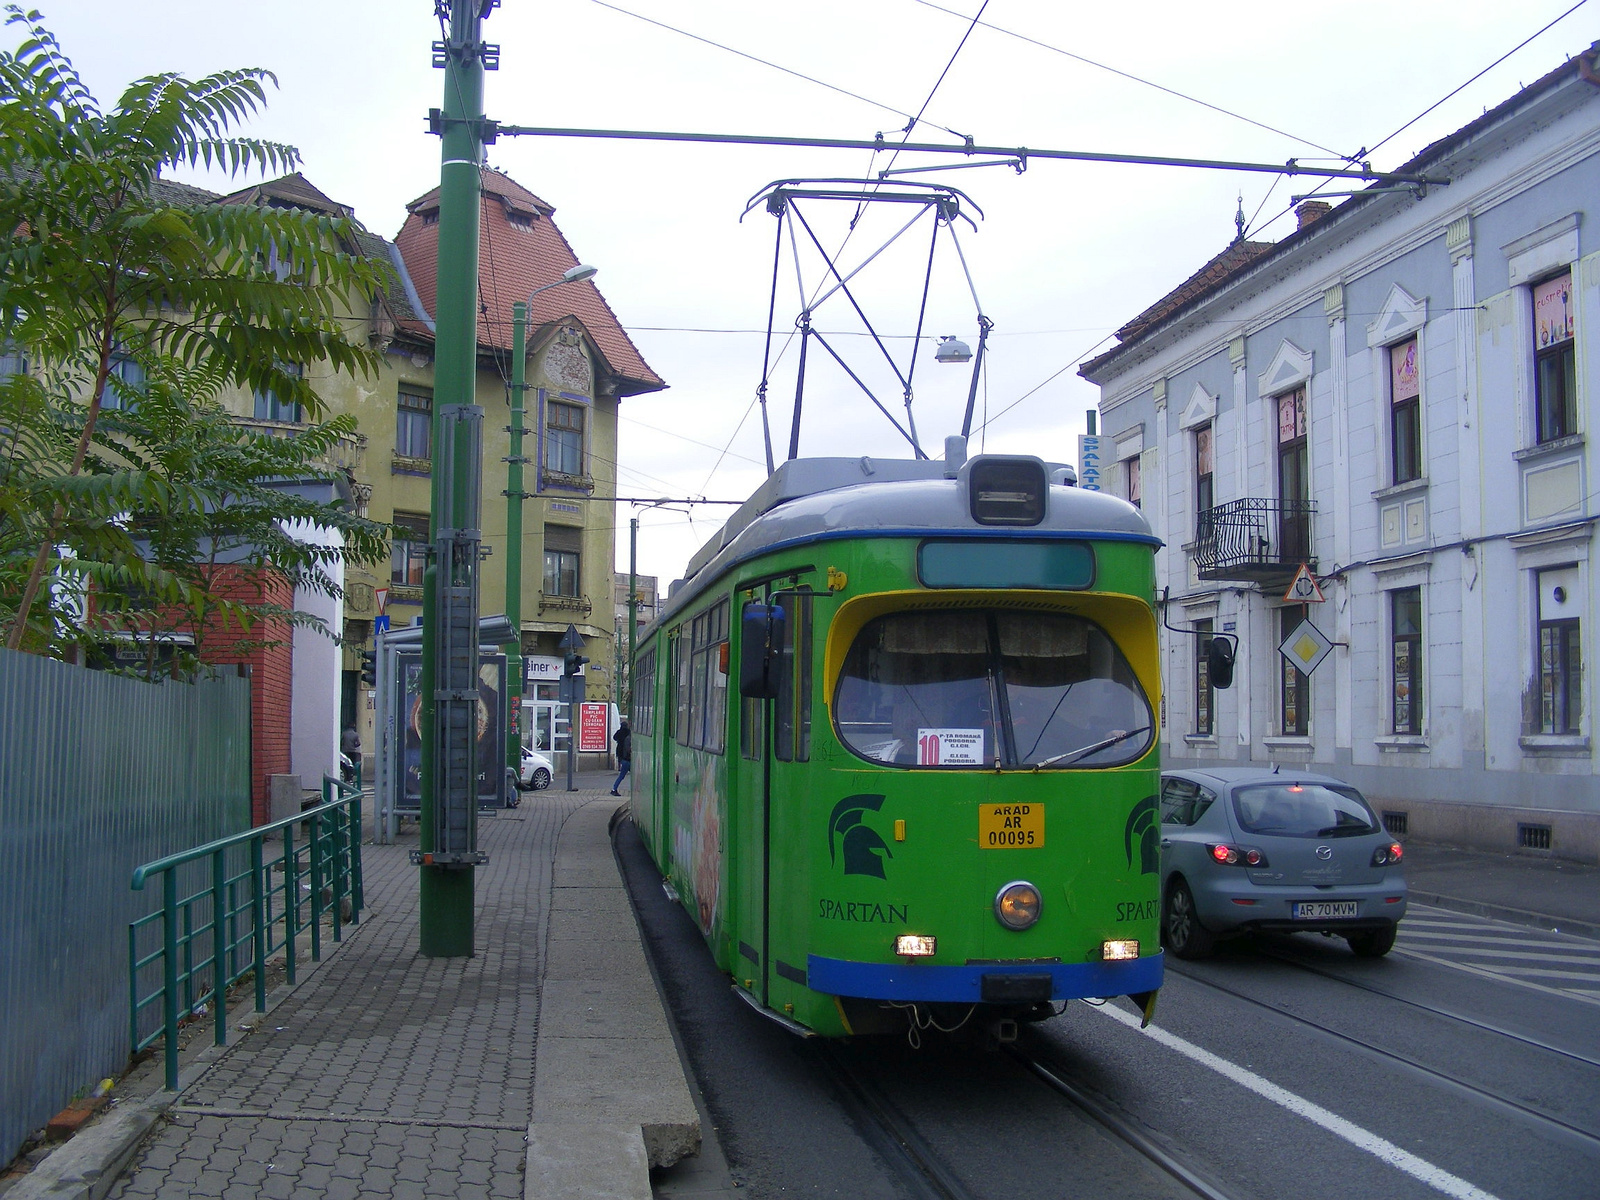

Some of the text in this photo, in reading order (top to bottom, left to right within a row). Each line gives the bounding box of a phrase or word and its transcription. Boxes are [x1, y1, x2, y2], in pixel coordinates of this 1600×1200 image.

[1082, 437, 1100, 491] SPALATO
[919, 735, 939, 766] 10
[994, 805, 1030, 816] ARAD
[1004, 816, 1022, 829] AR
[988, 831, 1035, 846] 00095
[819, 898, 909, 924] SPARTAN
[1116, 900, 1159, 922] SPART
[1299, 903, 1355, 916] AR 70 MVM
